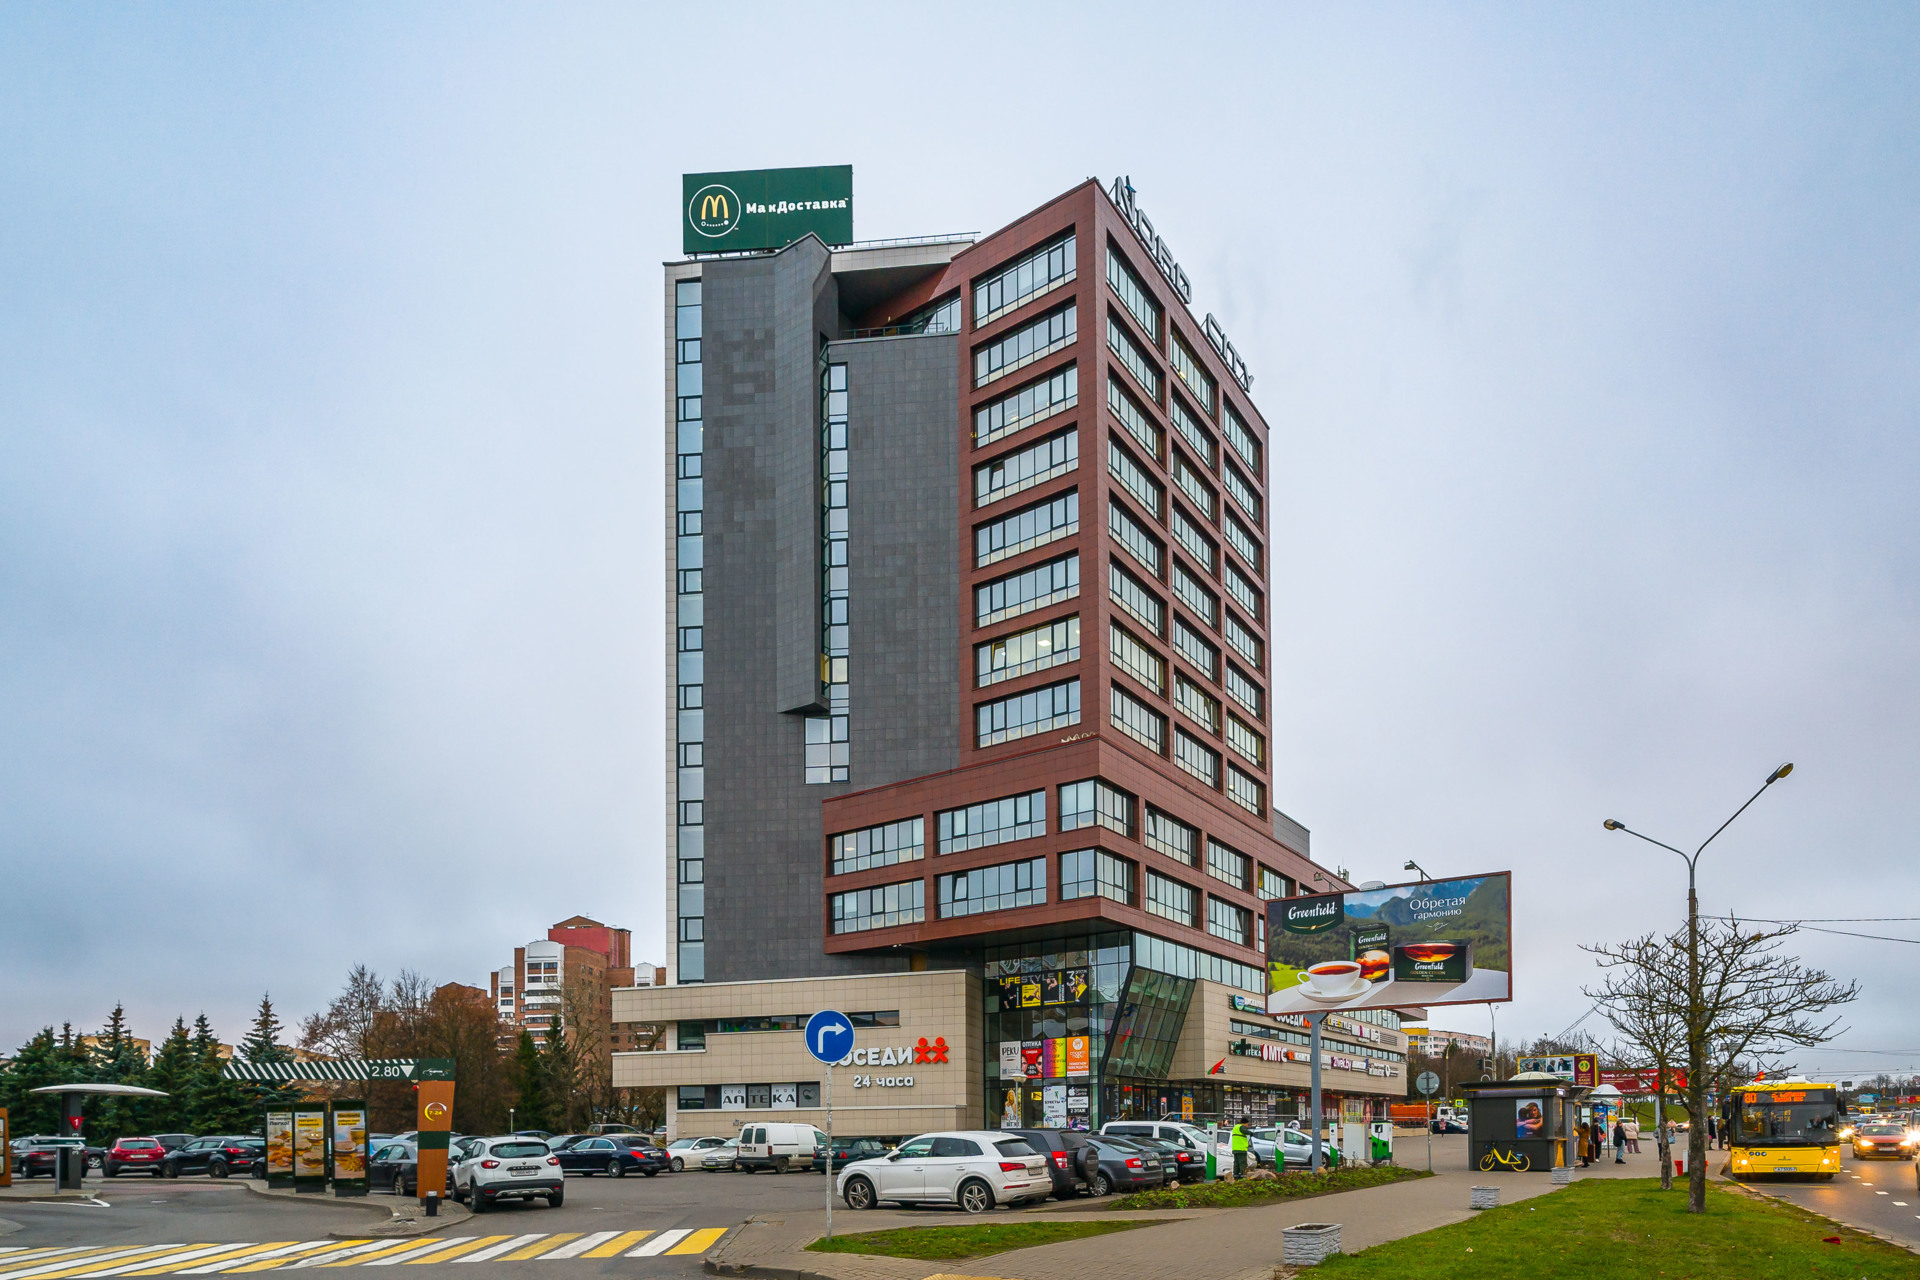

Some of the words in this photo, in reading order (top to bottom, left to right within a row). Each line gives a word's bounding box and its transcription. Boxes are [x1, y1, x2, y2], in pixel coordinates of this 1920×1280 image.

[1115, 175, 1192, 304] NORD
[1207, 312, 1254, 393] CITY
[1410, 897, 1466, 911] Обретая
[1288, 902, 1336, 920] Greenfield
[1413, 909, 1462, 920] гармонию
[1358, 933, 1387, 944] Greenfield
[1414, 962, 1444, 970] Greenfield
[1000, 972, 1054, 986] LIFESTYLE
[1066, 971, 1076, 986] 3
[831, 1046, 913, 1066] ОСЕДИ
[372, 1066, 400, 1077] 2.80
[854, 1075, 871, 1088] 24
[876, 1077, 913, 1087] часа
[723, 1094, 795, 1104] АПТЕКА
[1744, 1092, 1757, 1104] 80
[74, 1118, 79, 1126] 1
